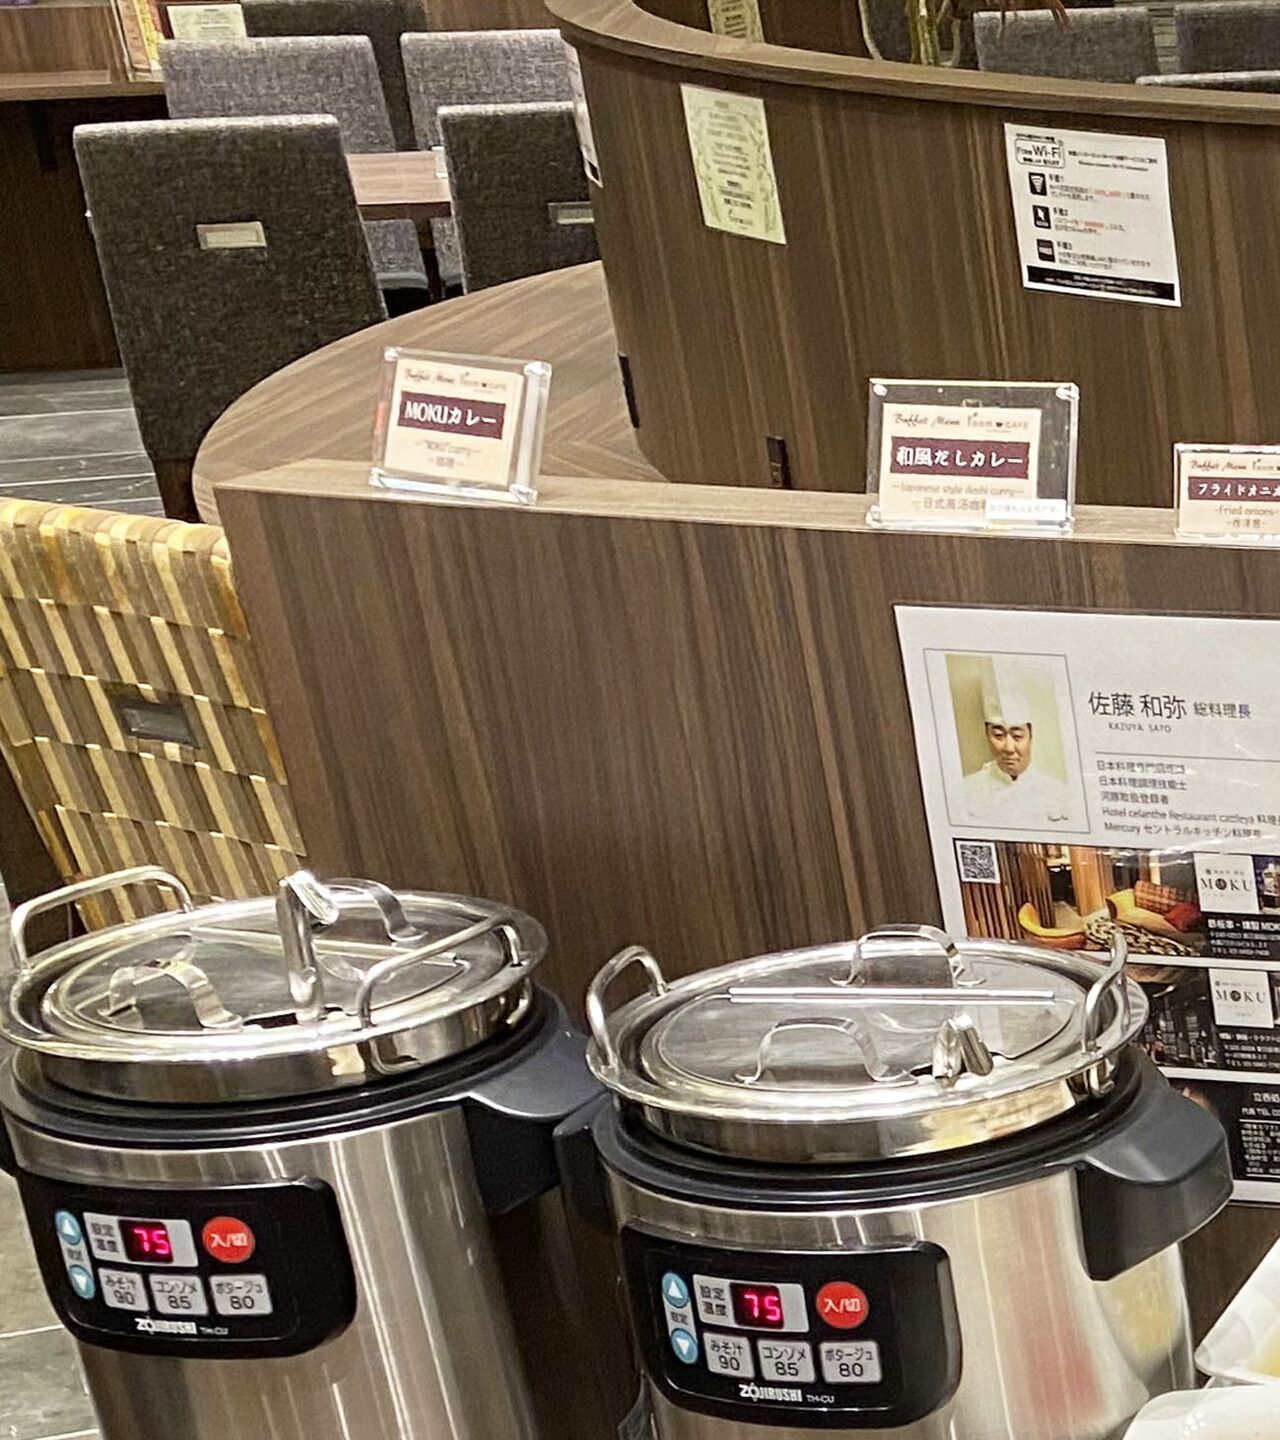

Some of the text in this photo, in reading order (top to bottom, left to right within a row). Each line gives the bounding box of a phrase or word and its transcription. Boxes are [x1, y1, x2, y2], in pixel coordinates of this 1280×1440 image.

[405, 400, 497, 426] MOKUカレー
[896, 446, 1024, 468] 和風だしカレー
[1088, 691, 1252, 720] 佐藤 和弥 総料理長
[1108, 722, 1171, 733] KAZUYA SATO
[1102, 807, 1127, 817] Hotel
[1104, 822, 1140, 834] Mercury
[1200, 877, 1252, 893] MOKU
[1215, 989, 1267, 1005] MOKU
[133, 1227, 171, 1254] 75
[210, 1232, 249, 1249] 入/切
[154, 1280, 197, 1294] コンソメ
[701, 1285, 725, 1301] 設定
[113, 1289, 255, 1310] 90 85 80
[743, 1293, 781, 1321] 75
[823, 1297, 861, 1314] 入/切
[711, 1339, 874, 1361] みそ汁 コンソメ ポタージュ
[718, 1355, 864, 1378] 90 85 80
[738, 1382, 803, 1402] ZOJIRUSHI
